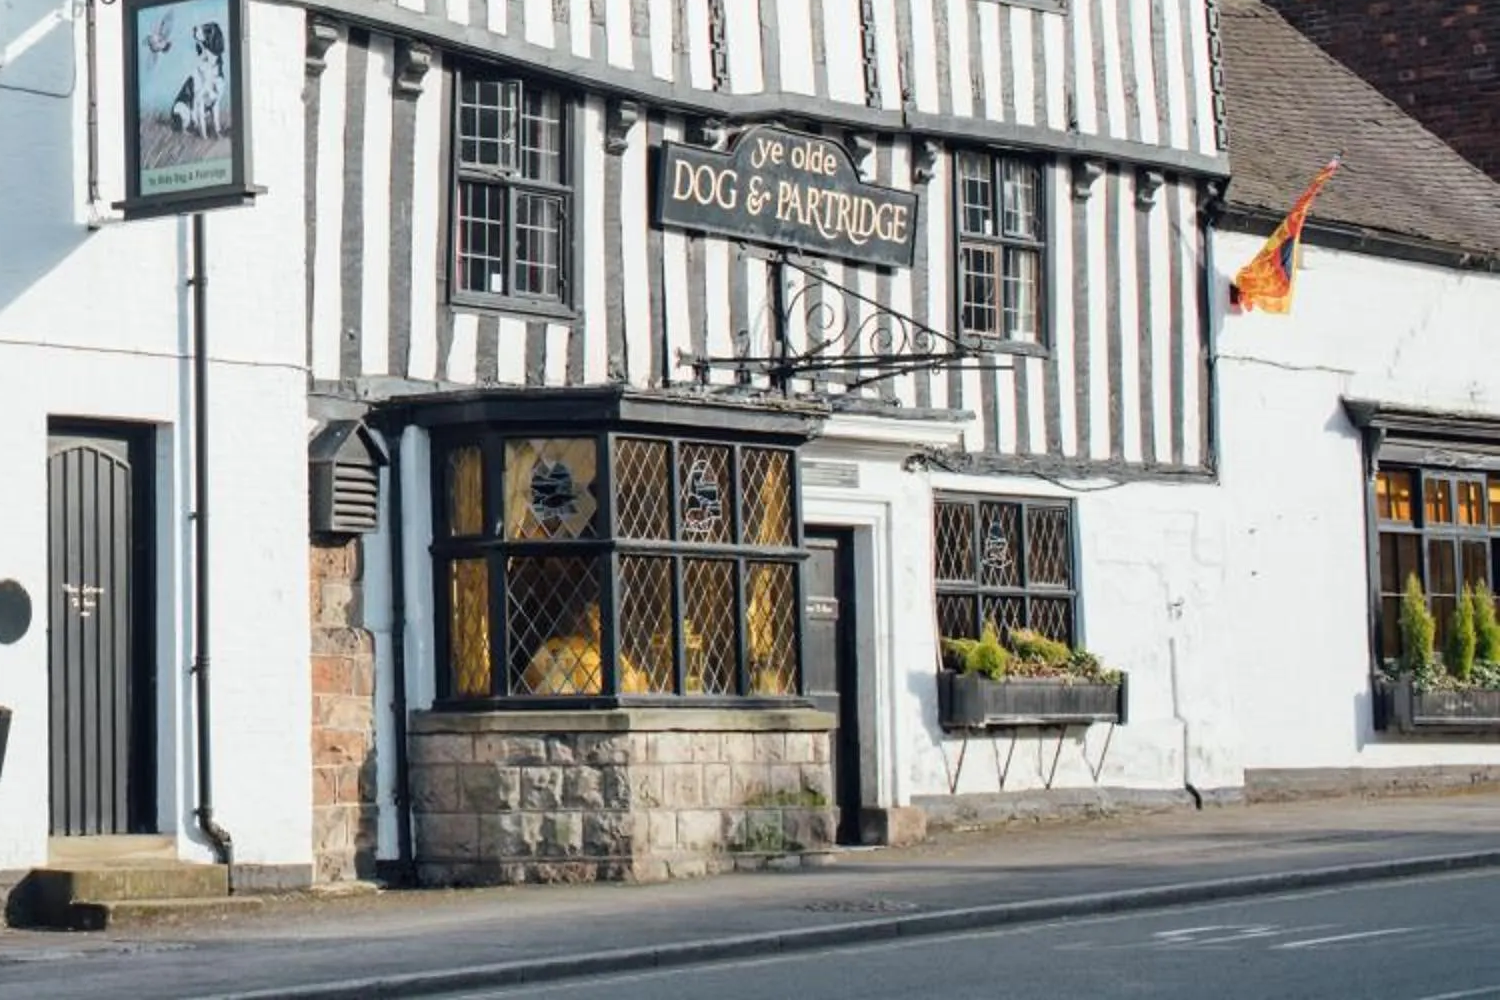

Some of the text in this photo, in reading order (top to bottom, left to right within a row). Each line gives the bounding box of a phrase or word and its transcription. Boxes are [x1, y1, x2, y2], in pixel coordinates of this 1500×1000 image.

[751, 137, 837, 176] ye olde
[673, 159, 908, 245] DOG & PARTRIDGE
